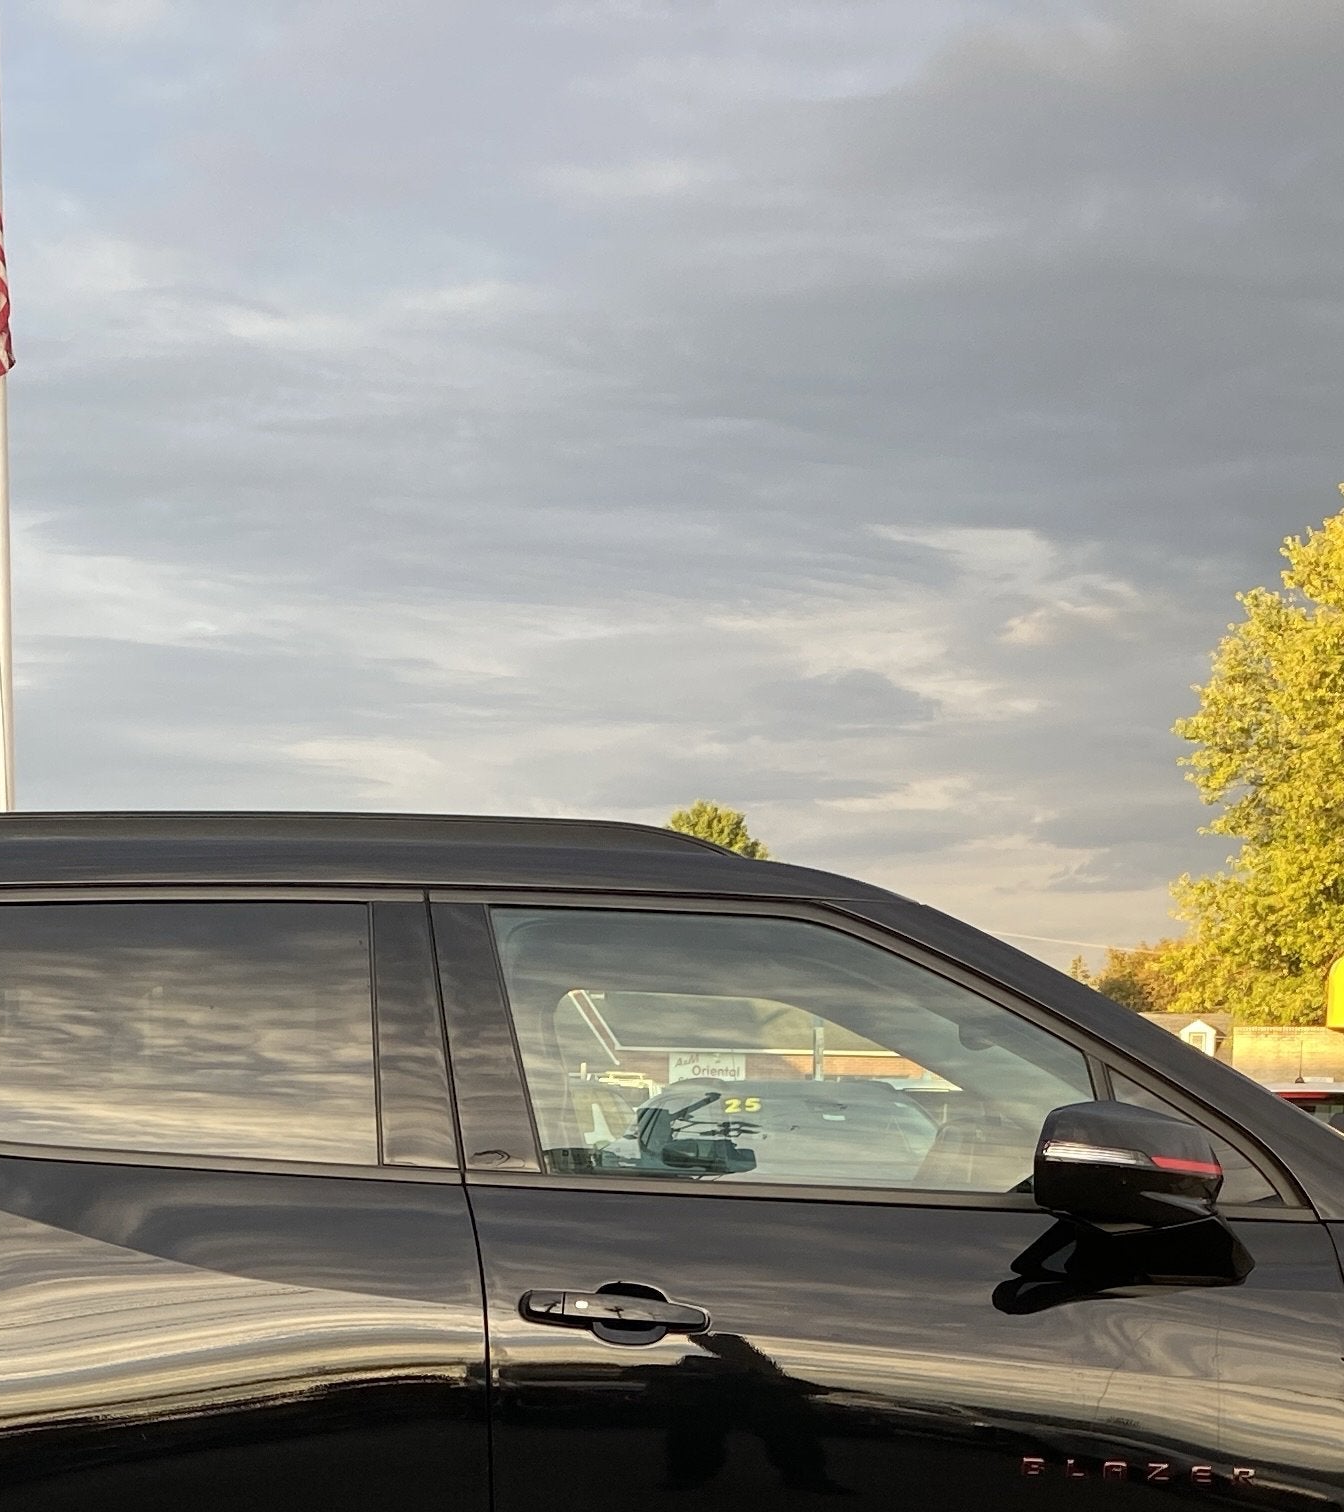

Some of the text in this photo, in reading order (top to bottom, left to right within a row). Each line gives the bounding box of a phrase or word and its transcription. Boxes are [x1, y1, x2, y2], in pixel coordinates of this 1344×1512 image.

[692, 1065, 740, 1077] Oriental
[724, 1096, 762, 1114] 25
[1021, 1457, 1256, 1485] BLAZER
